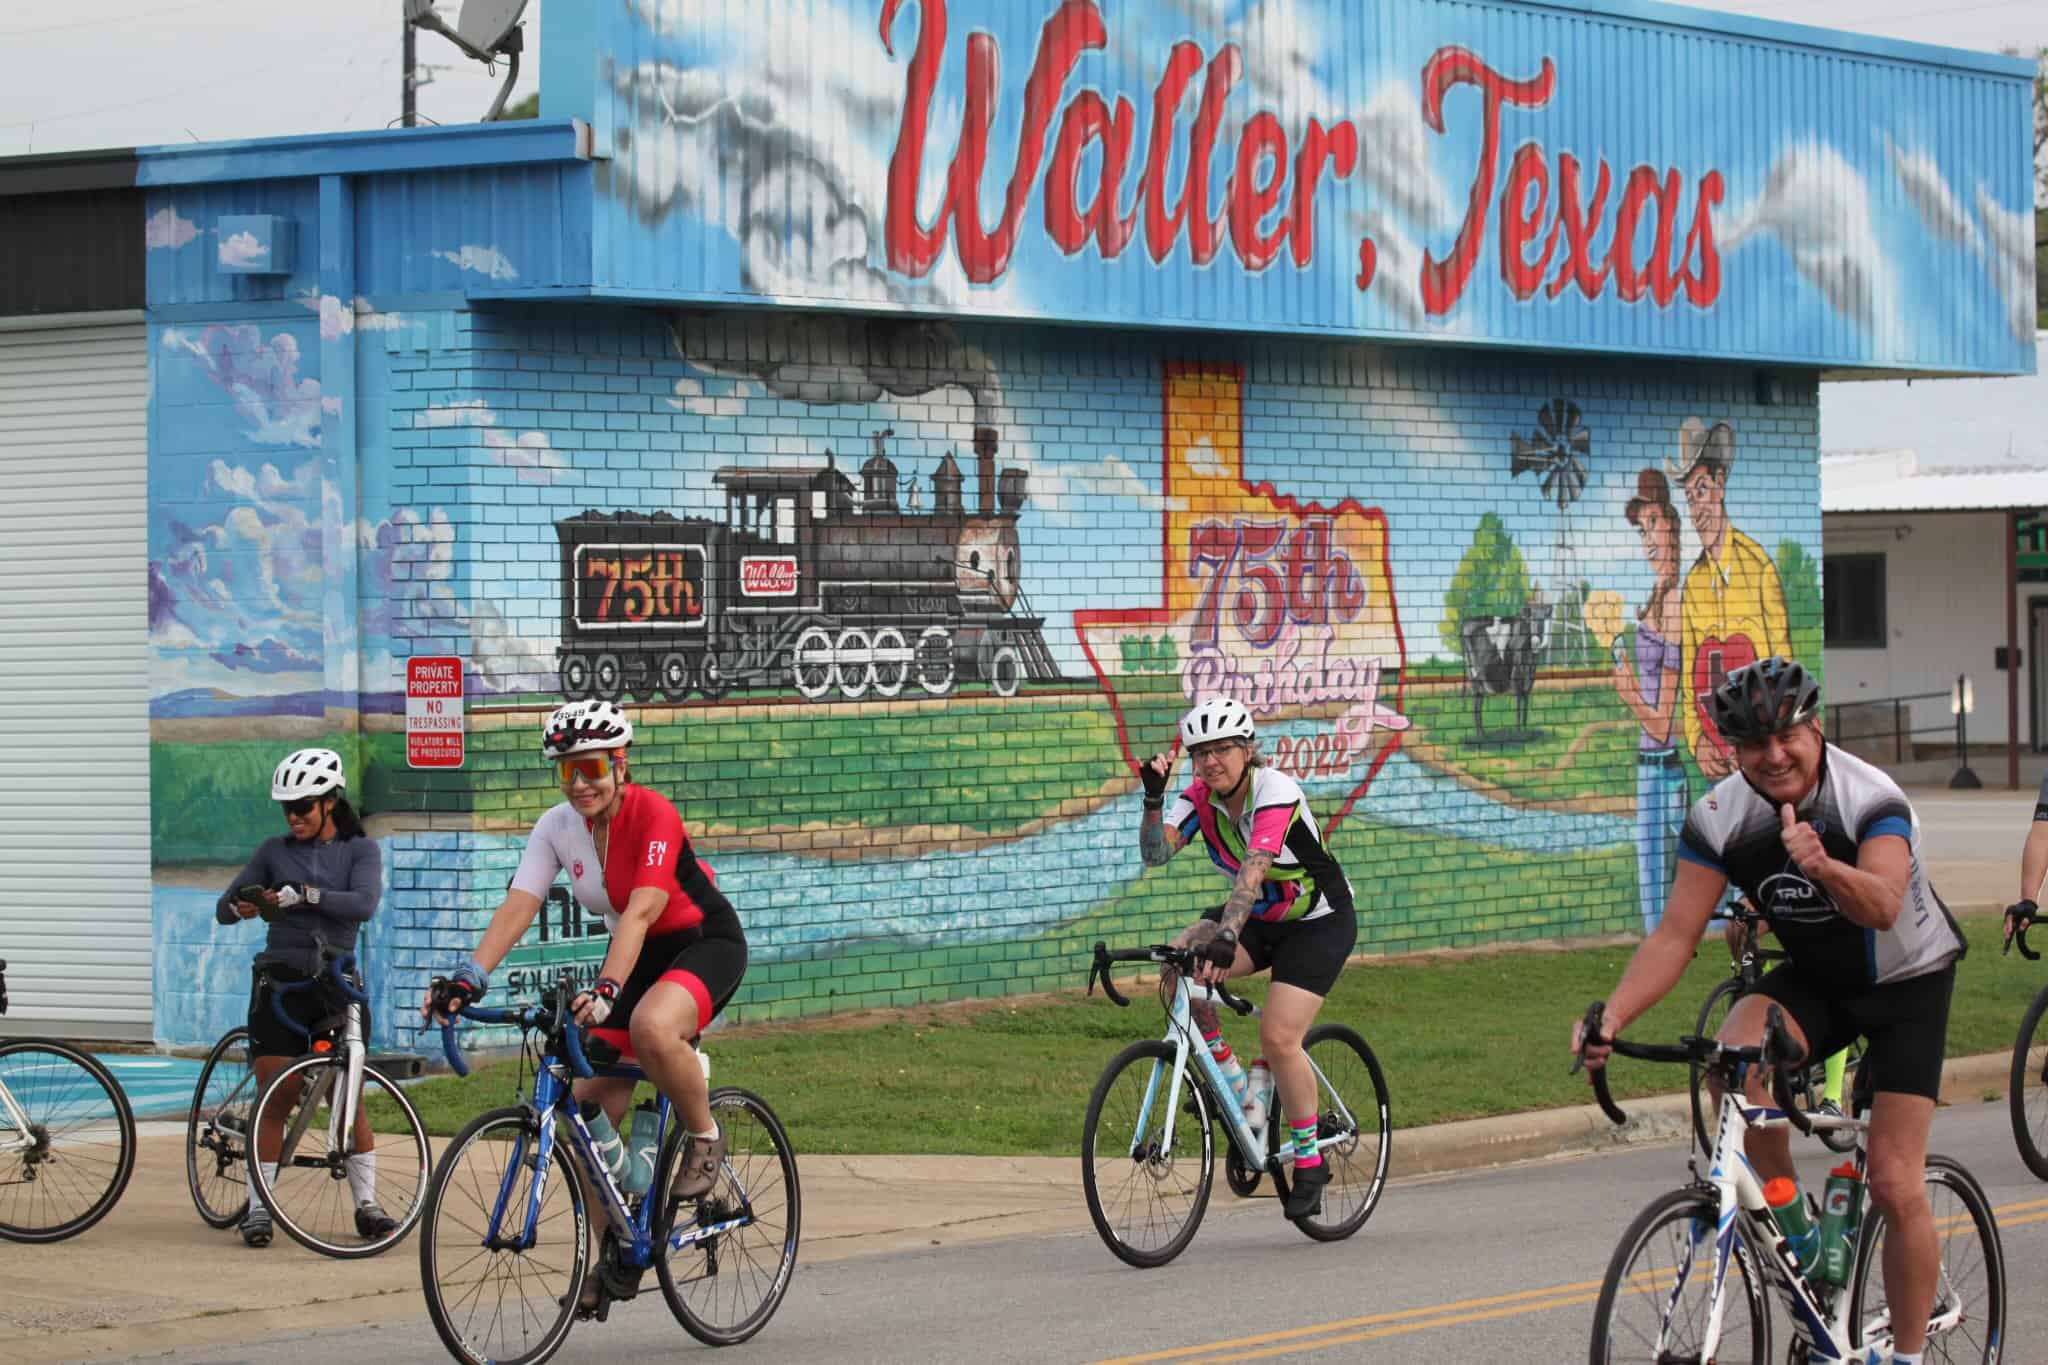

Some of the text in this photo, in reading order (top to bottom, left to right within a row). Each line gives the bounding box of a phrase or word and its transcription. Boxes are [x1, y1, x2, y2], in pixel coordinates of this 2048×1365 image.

[1421, 45, 1725, 316] Texas
[587, 553, 703, 623] 75th
[1188, 517, 1366, 650] 75th
[409, 681, 459, 694] PROPERTY
[415, 666, 454, 679] PRIVATE
[1182, 624, 1400, 752] Birthday
[408, 717, 461, 728] TRESPASSING
[426, 700, 443, 714] NO
